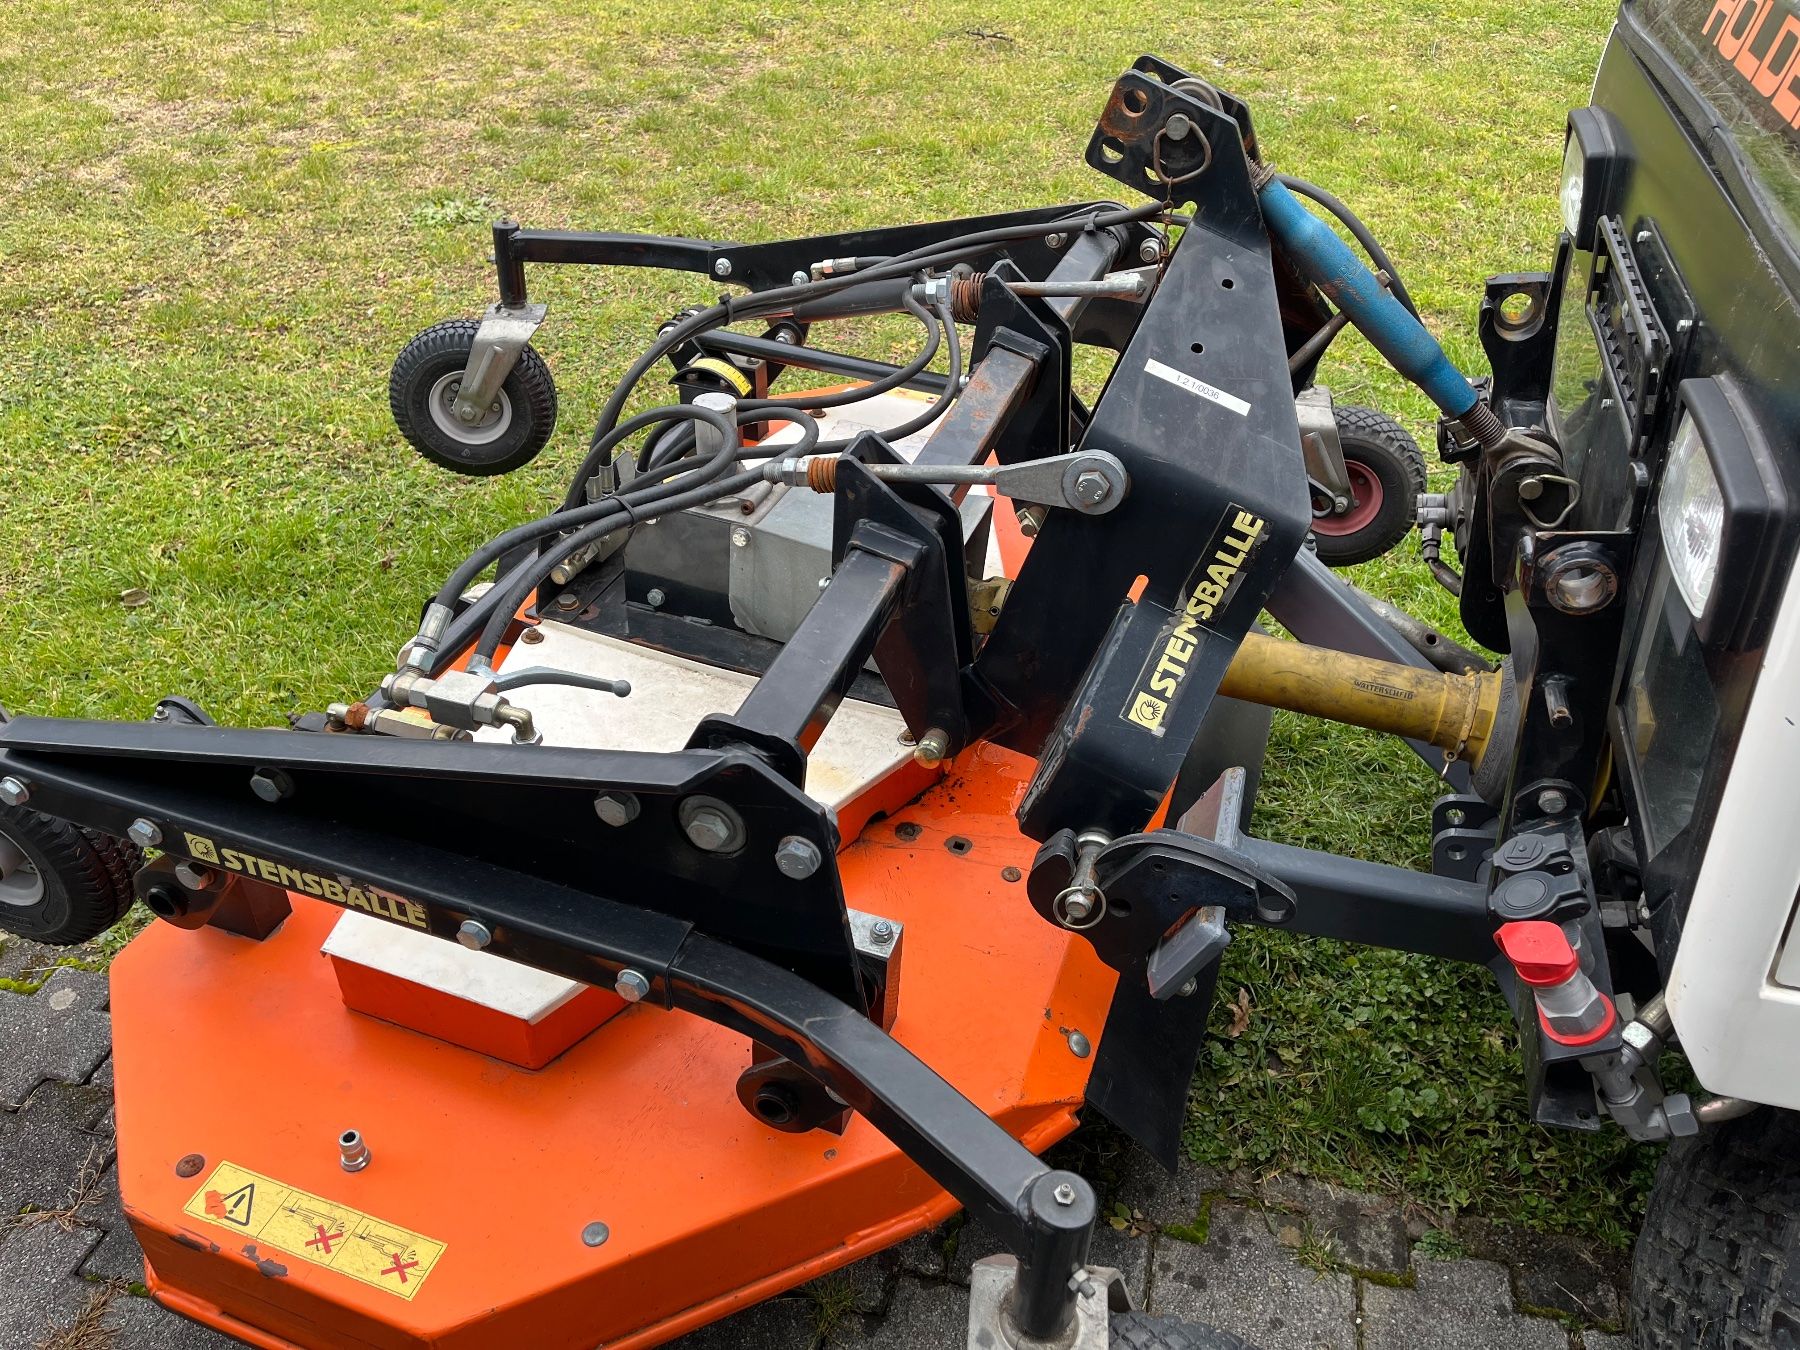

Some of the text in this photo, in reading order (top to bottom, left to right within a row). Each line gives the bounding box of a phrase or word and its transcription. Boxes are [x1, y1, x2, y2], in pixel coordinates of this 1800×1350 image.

[1701, 0, 1800, 131] HOLDE
[1150, 510, 1265, 699] STENSBALLE
[220, 848, 427, 929] STENSBALLE
